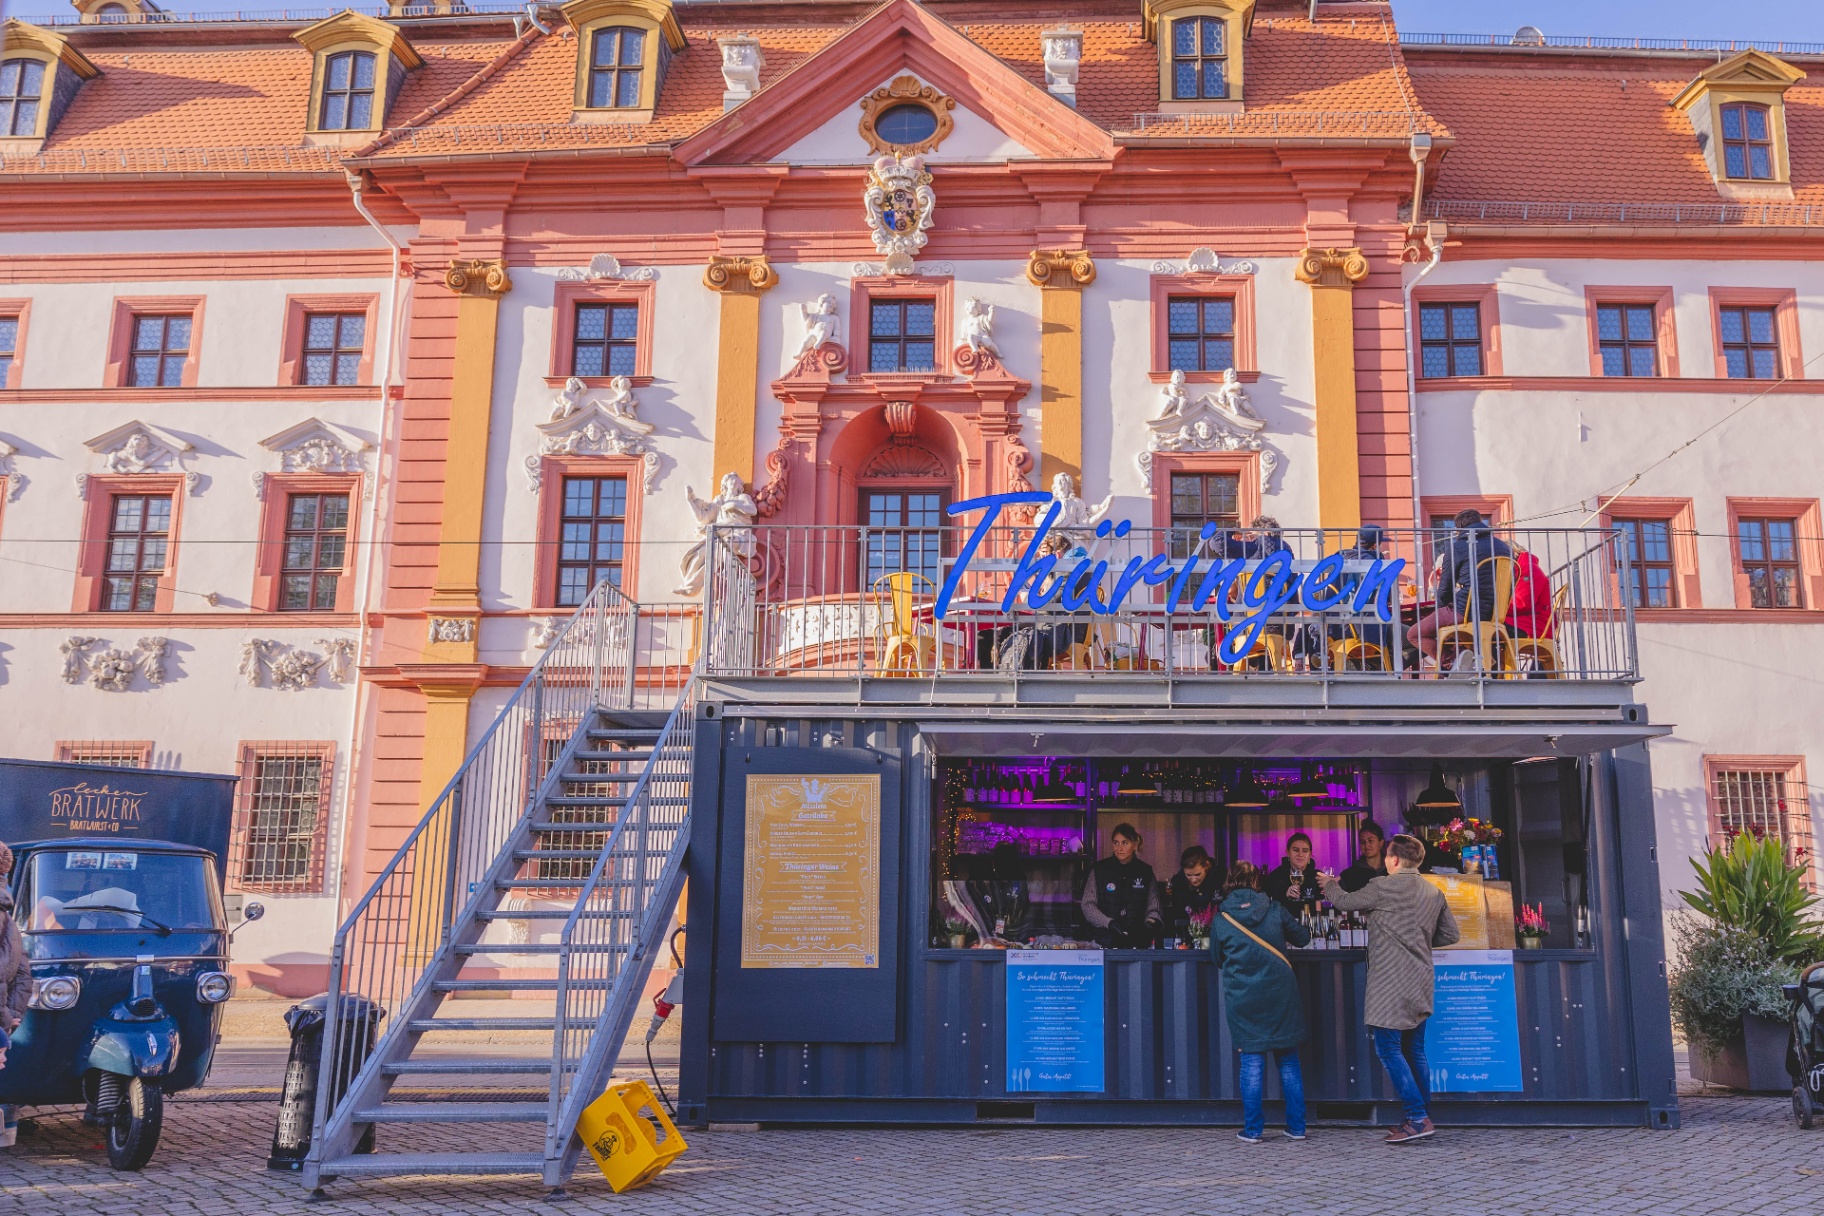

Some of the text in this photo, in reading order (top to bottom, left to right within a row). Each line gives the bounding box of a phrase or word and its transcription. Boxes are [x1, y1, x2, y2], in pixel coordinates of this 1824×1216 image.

[935, 490, 1406, 665] Thüringen
[51, 793, 142, 821] BRATWERK
[69, 819, 108, 831] BRATWURST
[1017, 971, 1026, 981] So
[1027, 971, 1057, 982] schmeckt
